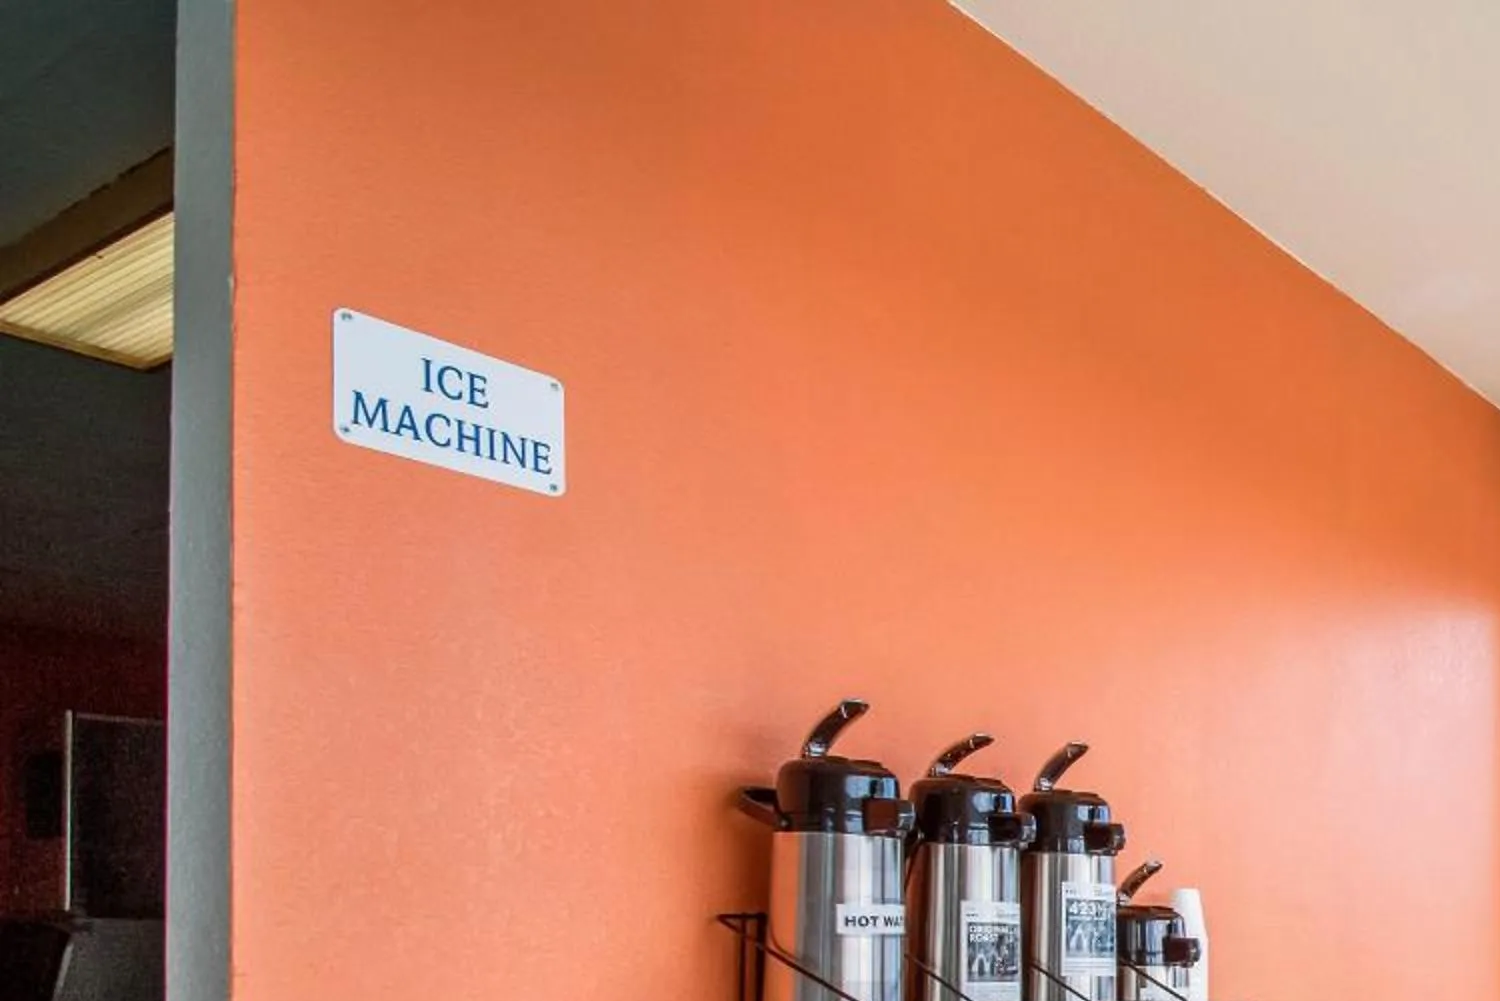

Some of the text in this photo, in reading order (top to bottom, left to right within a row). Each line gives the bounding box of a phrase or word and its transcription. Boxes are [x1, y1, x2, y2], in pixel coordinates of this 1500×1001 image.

[421, 357, 489, 409] ICE
[351, 389, 553, 475] MACHINE
[844, 915, 879, 927] HOT
